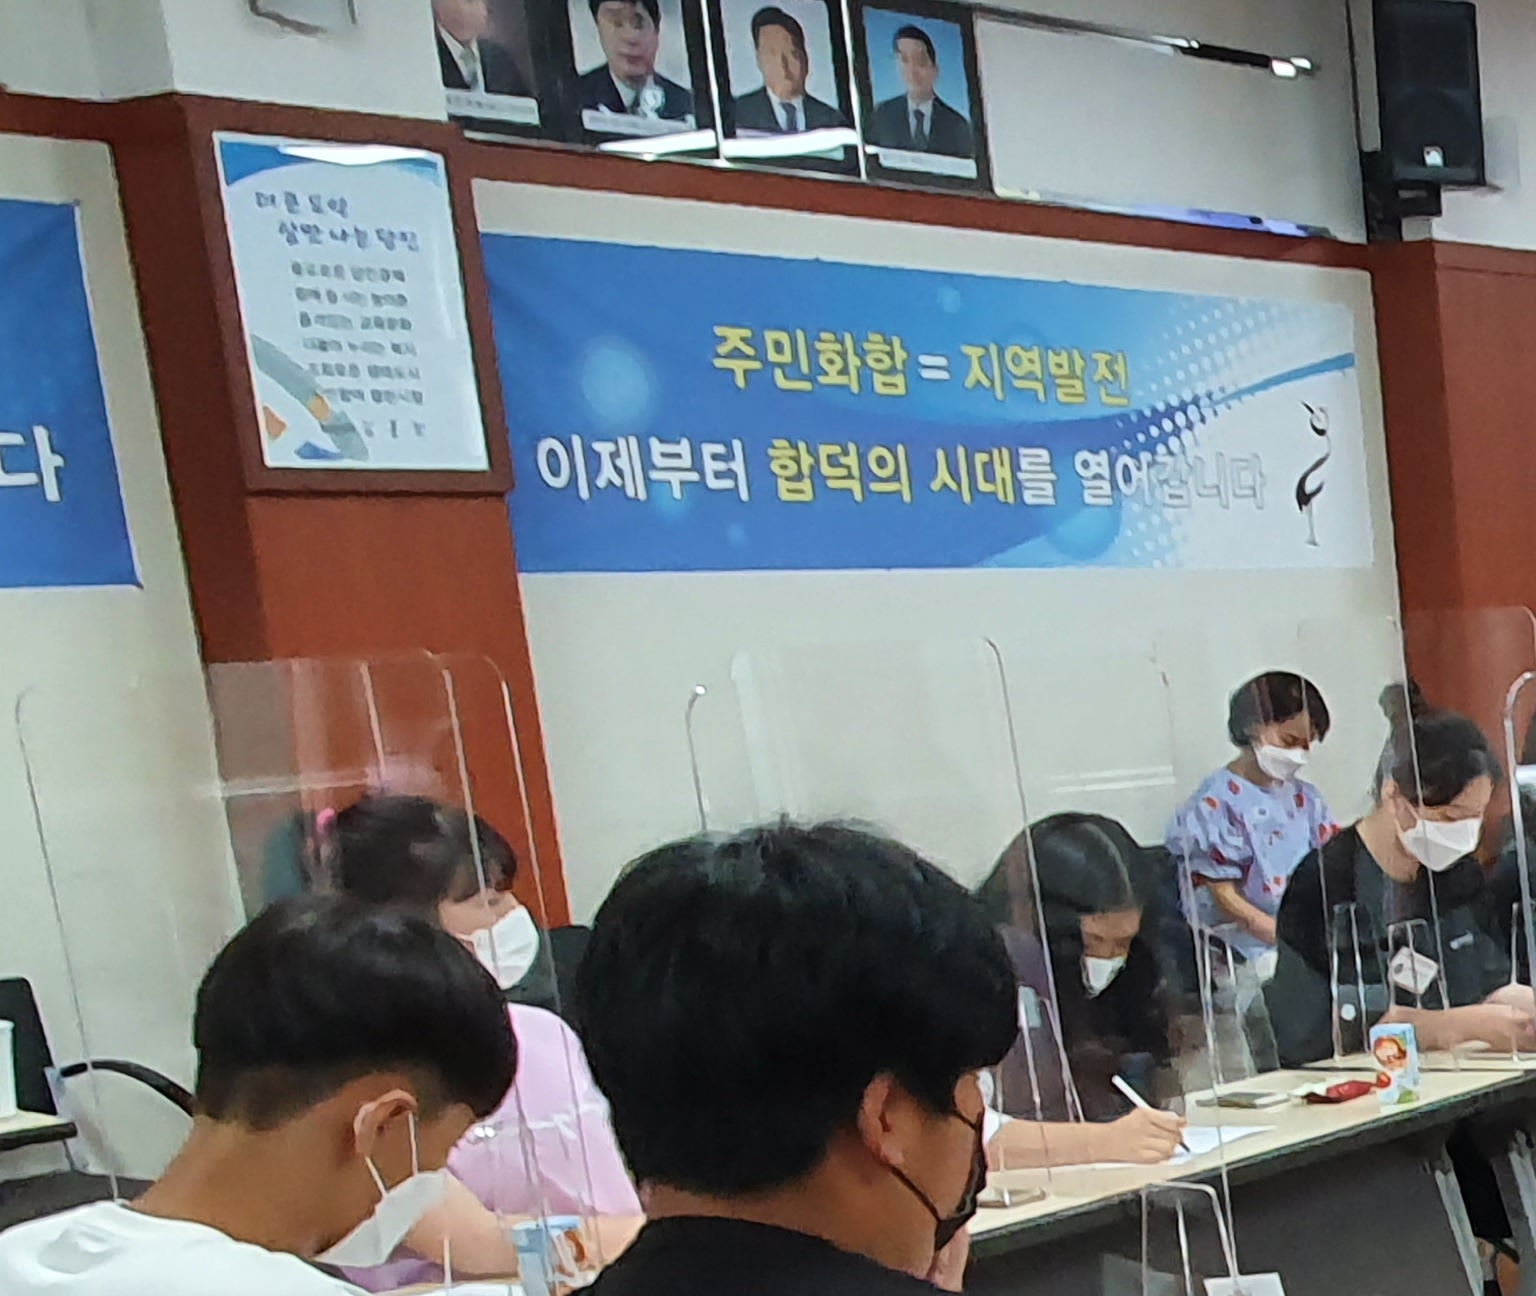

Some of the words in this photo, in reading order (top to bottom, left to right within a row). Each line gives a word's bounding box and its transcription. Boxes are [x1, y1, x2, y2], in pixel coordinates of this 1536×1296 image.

[711, 324, 909, 397] 주민화합
[960, 342, 1130, 406] 지역발전
[536, 433, 750, 502] 이제부터
[767, 438, 912, 503] 합덕의
[929, 444, 1058, 507] 시대를
